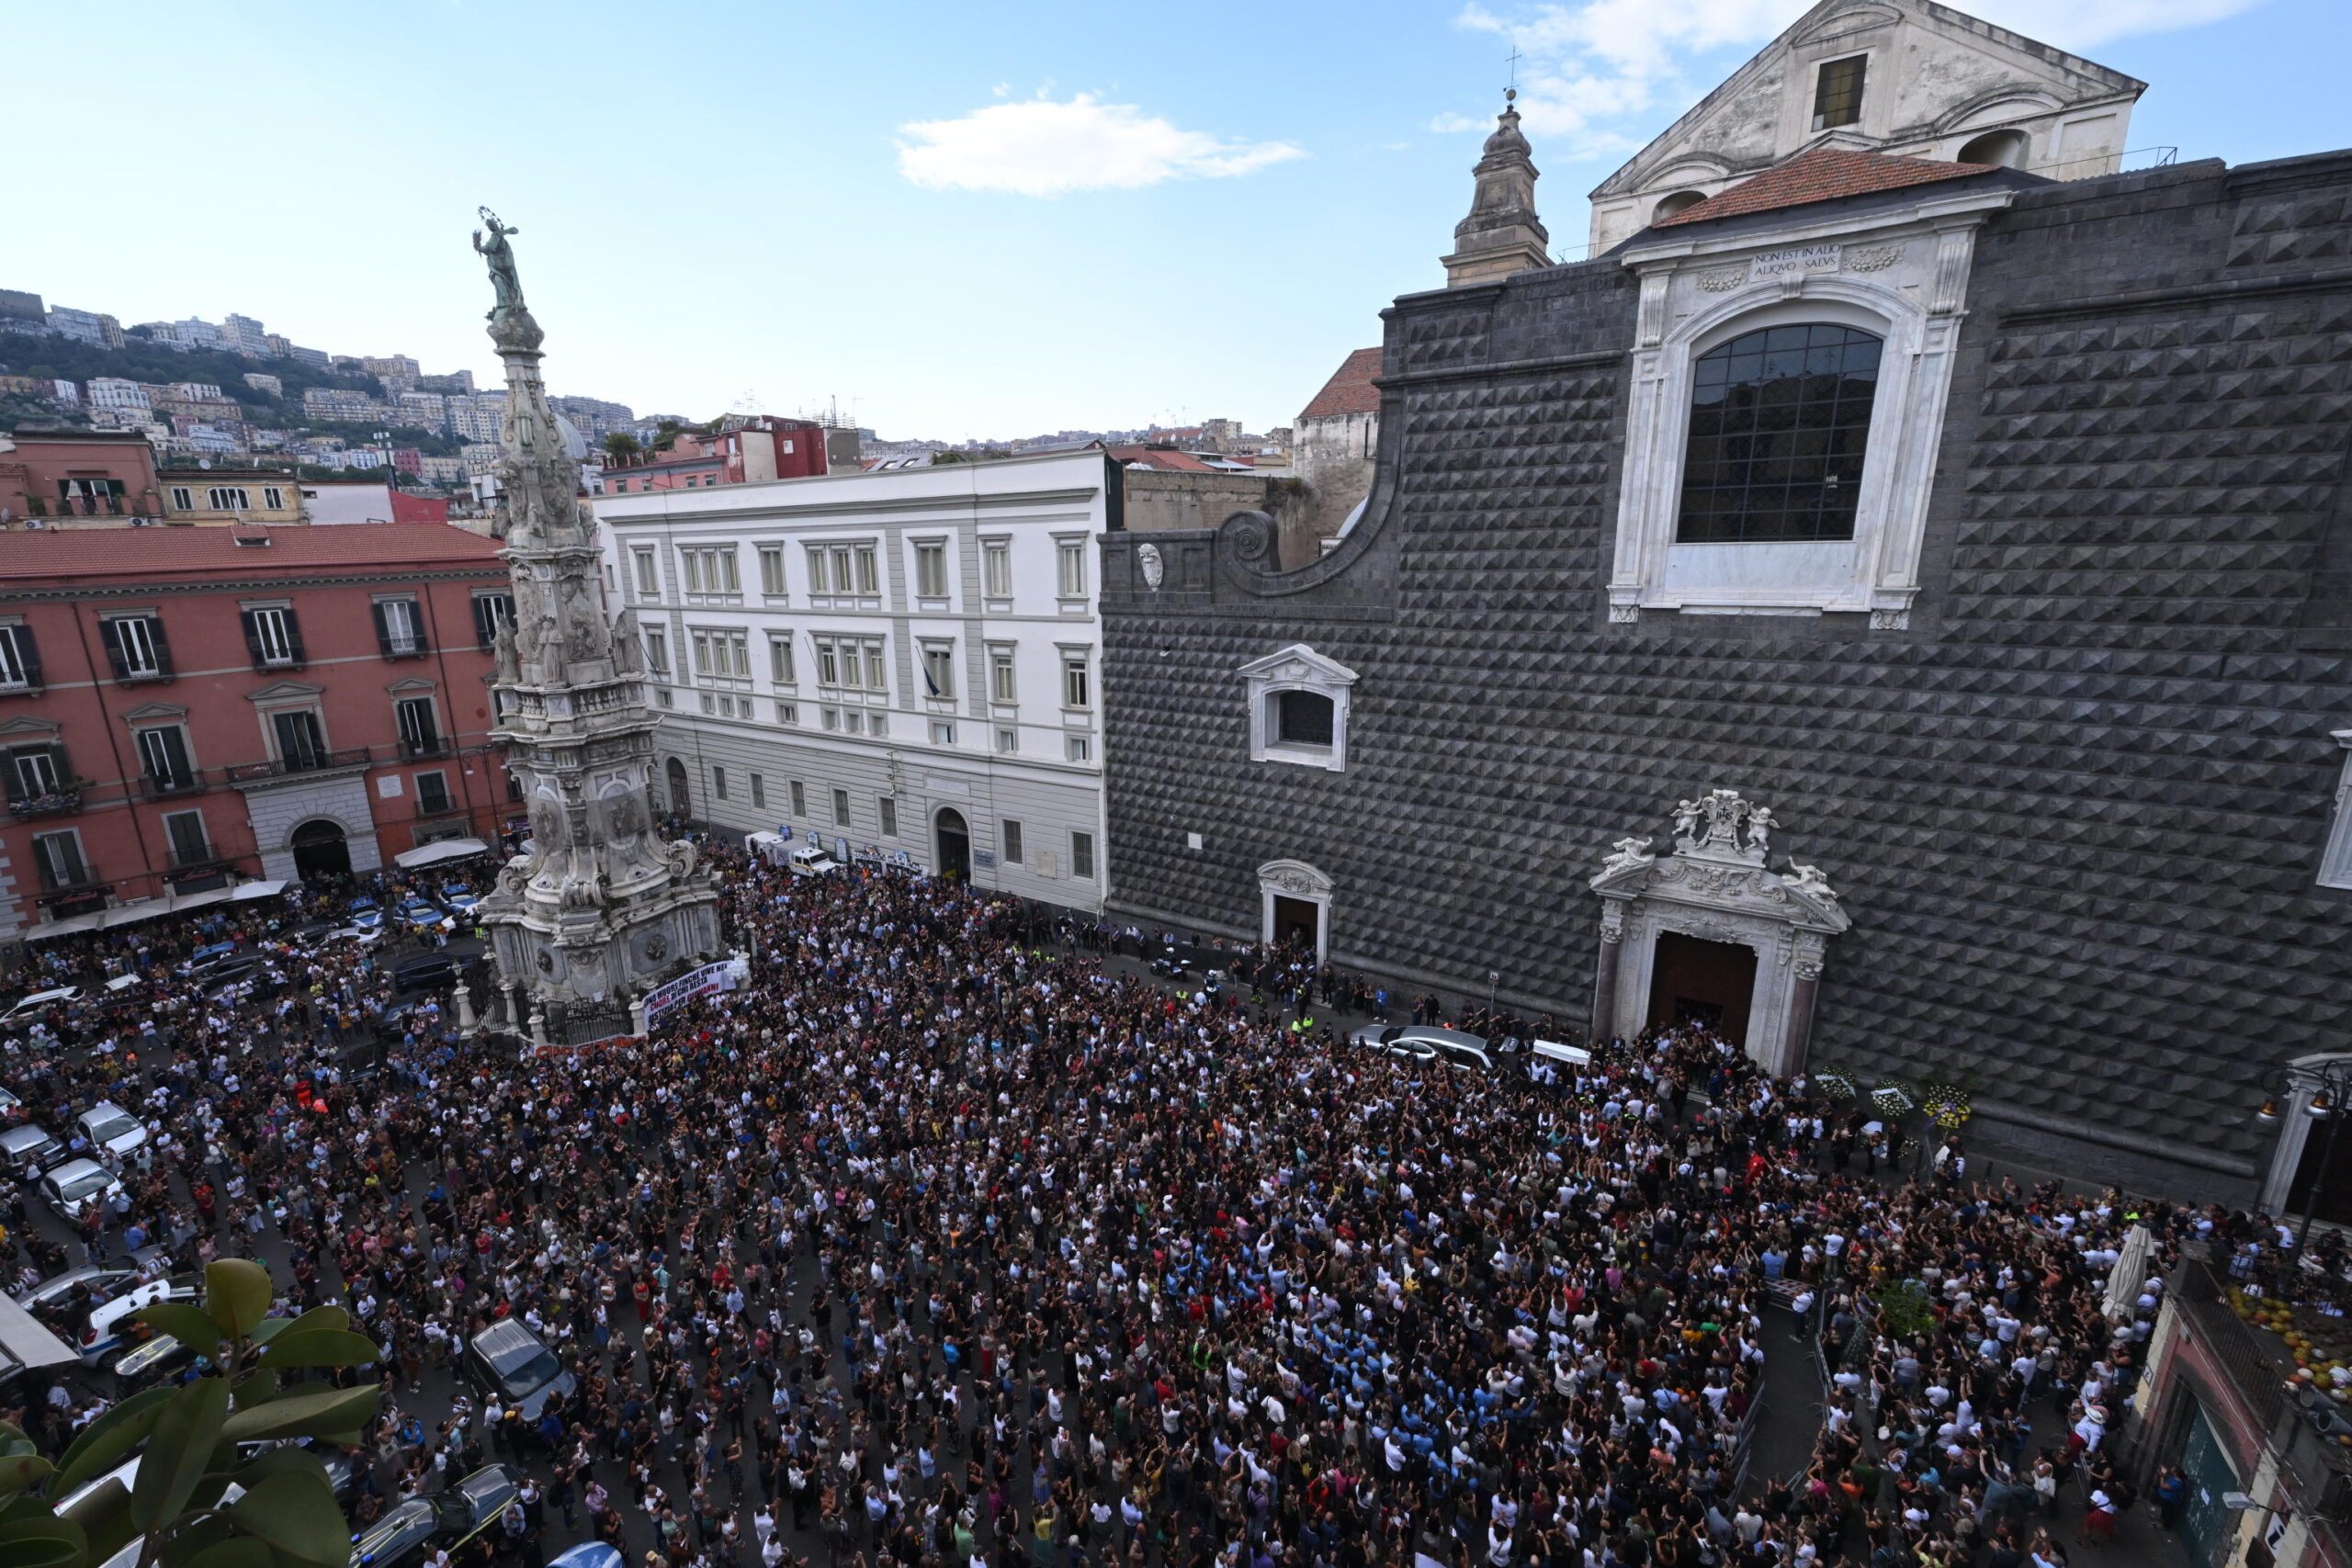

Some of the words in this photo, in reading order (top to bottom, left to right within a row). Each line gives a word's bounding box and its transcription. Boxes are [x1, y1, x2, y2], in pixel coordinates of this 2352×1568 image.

[1756, 252, 1780, 264] NON
[1782, 250, 1799, 260] EST
[1802, 248, 1814, 258] IN
[1815, 244, 1840, 256] ALIO
[1756, 263, 1796, 276] ALIQVO
[1805, 256, 1836, 268] SALVS
[701, 965, 715, 977] VIVE
[650, 994, 671, 1011] CUORE
[678, 985, 688, 996] CHI
[689, 976, 707, 991] RESTA
[674, 996, 686, 1009] PER
[687, 982, 719, 1001] GIOVANNI
